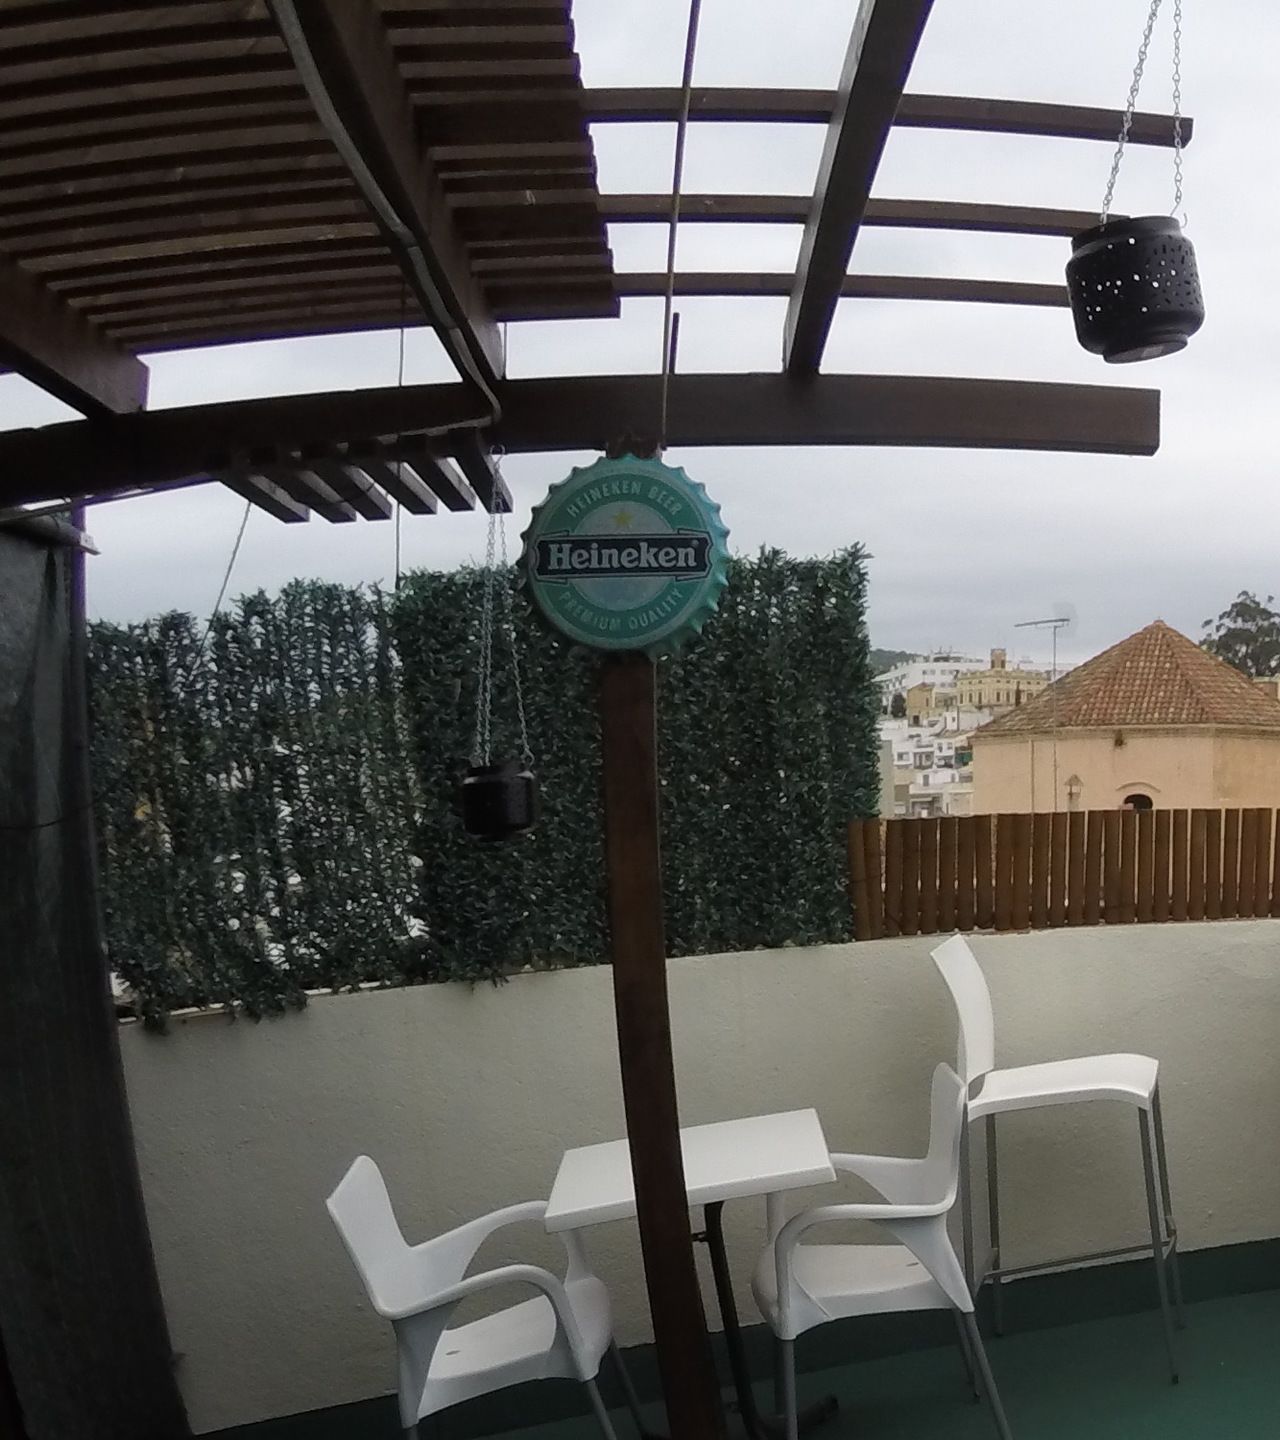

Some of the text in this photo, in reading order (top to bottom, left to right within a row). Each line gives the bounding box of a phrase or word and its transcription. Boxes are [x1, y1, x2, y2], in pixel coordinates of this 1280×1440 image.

[566, 479, 683, 518] HEINEKEN BEER
[547, 542, 698, 571] Heineken
[558, 588, 684, 631] PREMIUM QUALITY
